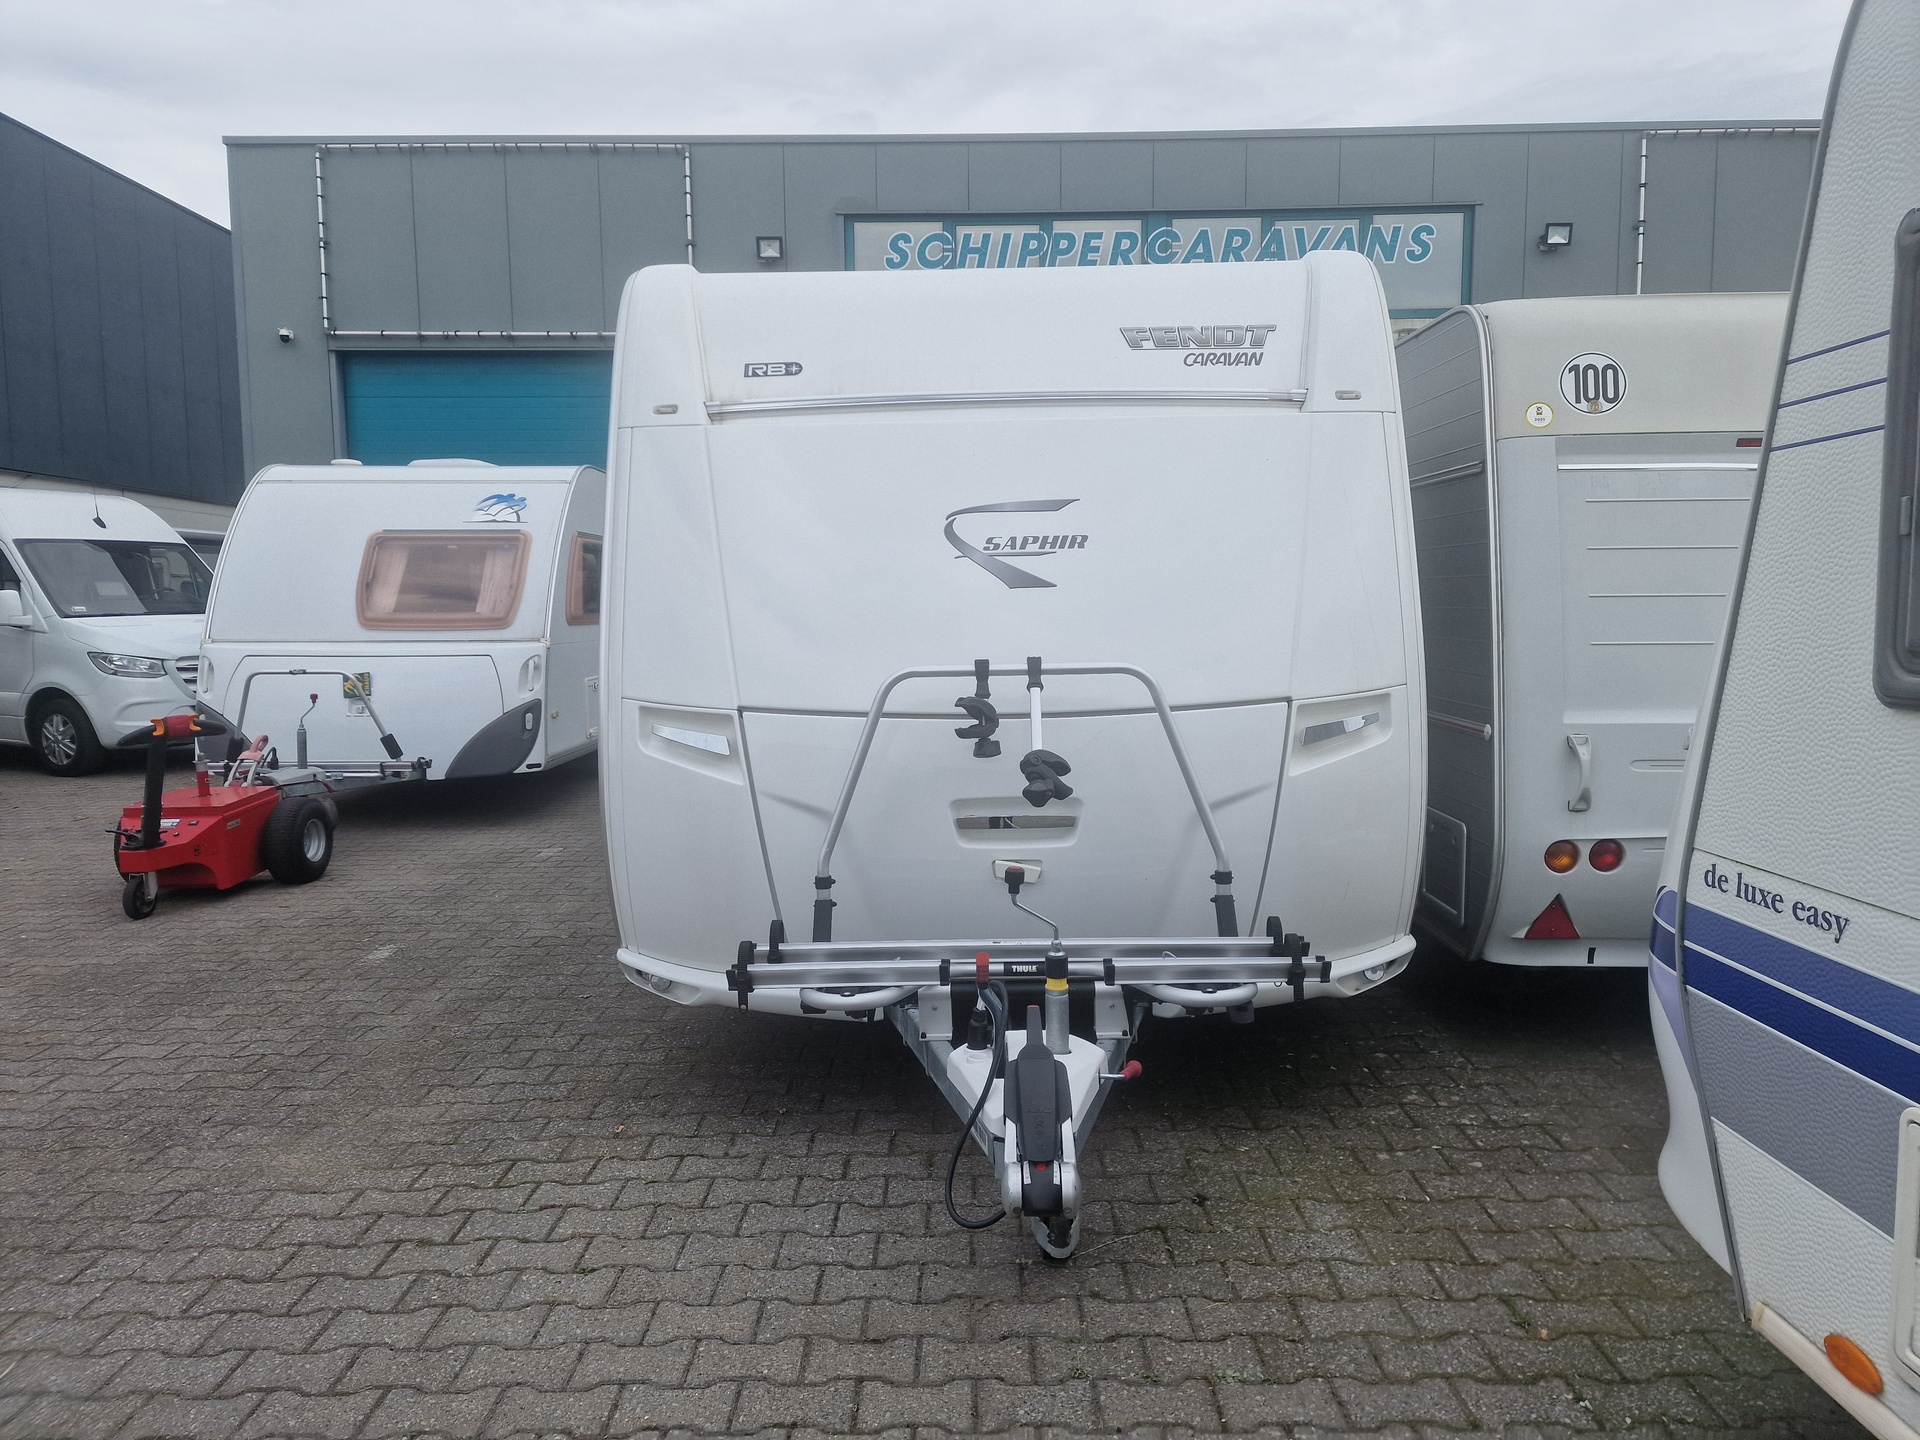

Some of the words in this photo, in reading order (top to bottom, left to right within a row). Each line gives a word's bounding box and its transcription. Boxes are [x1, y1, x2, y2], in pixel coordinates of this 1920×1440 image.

[1120, 325, 1277, 348] FENDT
[1183, 352, 1264, 367] CARAVAN
[1568, 363, 1620, 404] 100
[982, 534, 1089, 551] SAPHIR
[1704, 863, 1729, 893] de
[1735, 872, 1784, 914] luxe
[1792, 900, 1850, 944] easy
[1011, 965, 1038, 973] THULE
